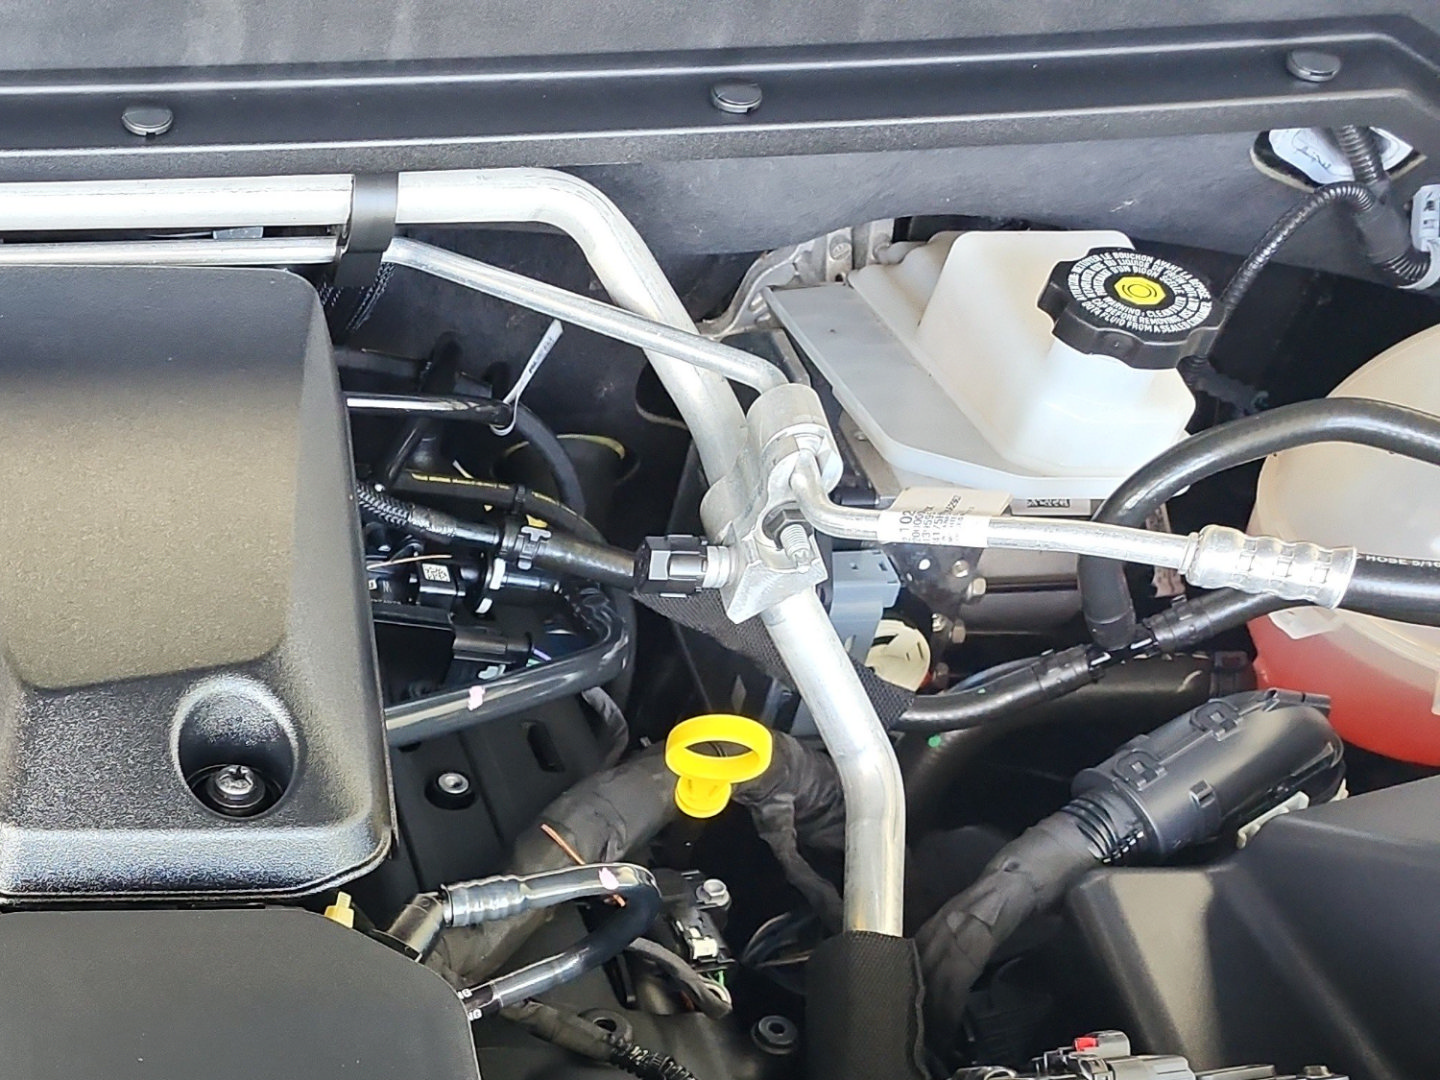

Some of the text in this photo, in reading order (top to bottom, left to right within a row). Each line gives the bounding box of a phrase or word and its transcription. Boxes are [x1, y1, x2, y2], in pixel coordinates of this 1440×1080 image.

[1112, 252, 1154, 263] BOUCHON
[1153, 259, 1183, 271] AVANT
[1132, 265, 1160, 278] BIDON
[1105, 306, 1138, 320] BEFORE
[1099, 312, 1125, 326] FLUID
[1126, 321, 1152, 332] FROM
